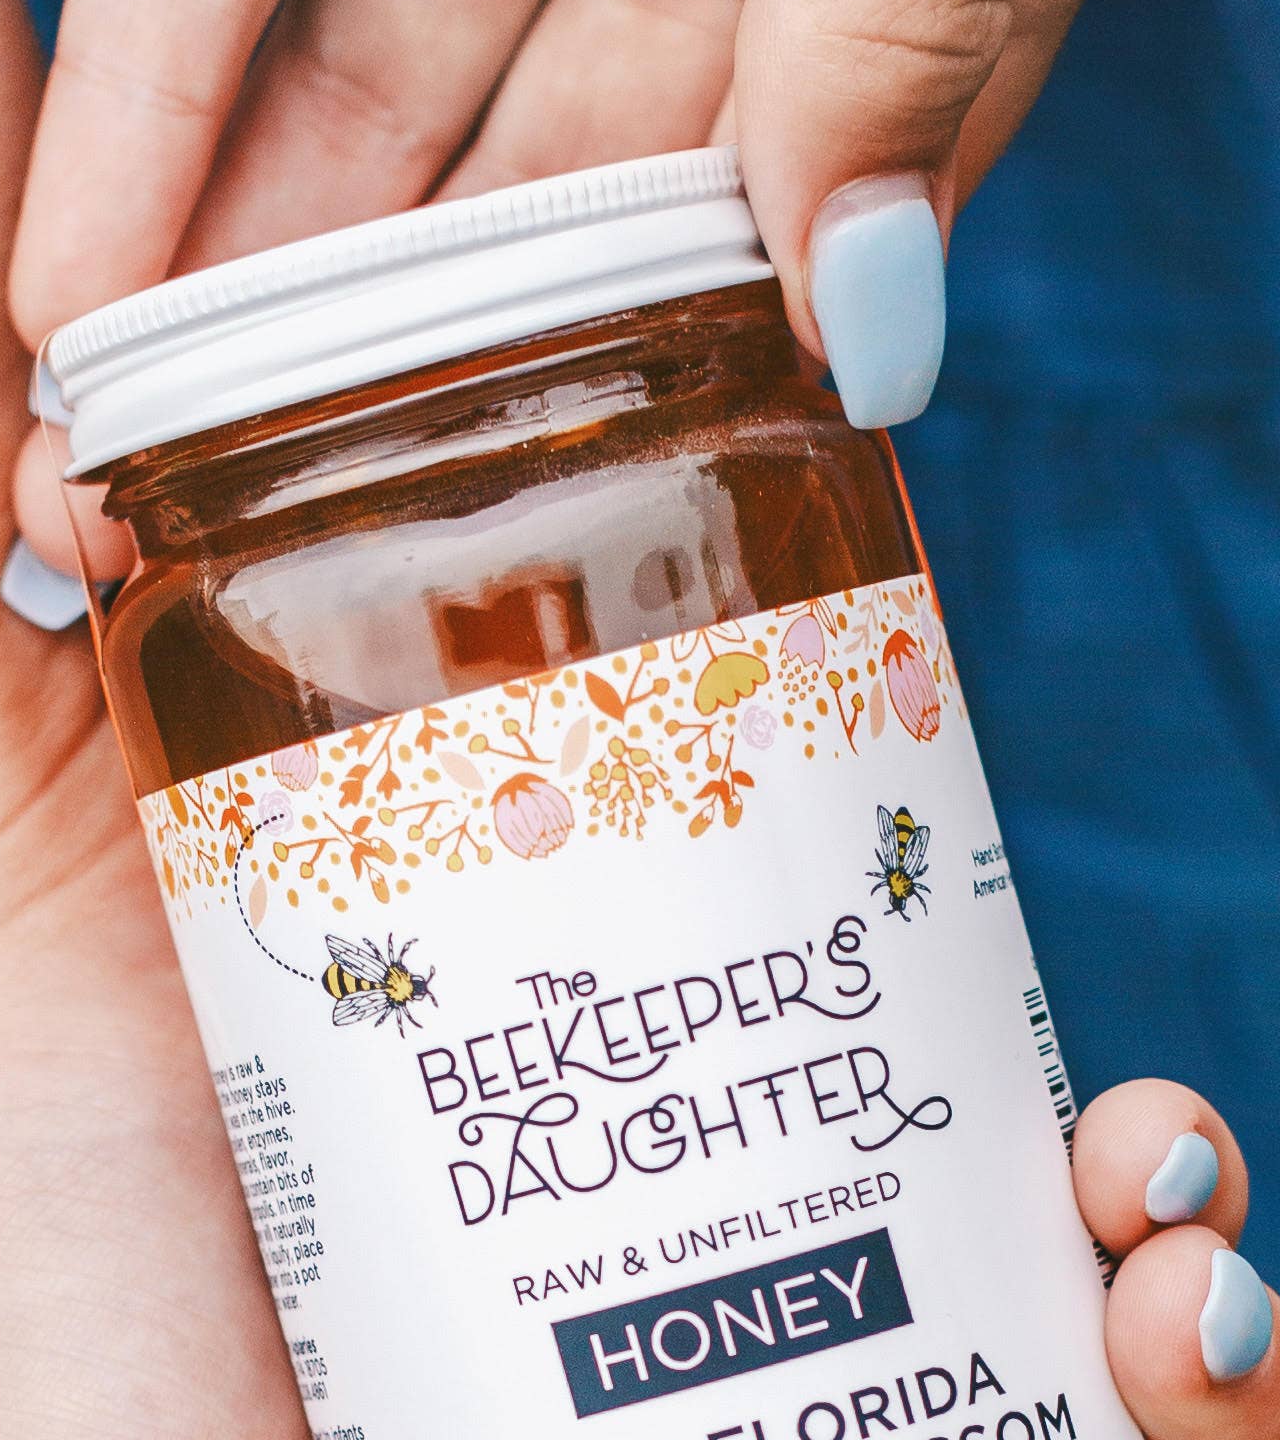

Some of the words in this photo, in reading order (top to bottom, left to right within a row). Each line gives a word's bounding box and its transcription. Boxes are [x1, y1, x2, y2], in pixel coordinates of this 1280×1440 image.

[515, 970, 597, 1010] The
[417, 915, 882, 1115] BEEKEEPER'S
[235, 1060, 253, 1079] raw
[254, 1054, 265, 1074] &
[255, 1077, 287, 1099] stays
[248, 1106, 265, 1125] the
[264, 1099, 296, 1121] hive.
[247, 1126, 293, 1150] enzymes,
[448, 1046, 953, 1226] DAUGHTER
[259, 1150, 295, 1172] flavor,
[277, 1169, 300, 1191] bits
[301, 1163, 316, 1185] of
[287, 1192, 317, 1213] time
[272, 1214, 316, 1239] naturally
[512, 1255, 604, 1306] RAW
[622, 1246, 649, 1276] &
[659, 1171, 902, 1265] UNFILTERED
[293, 1239, 324, 1261] place
[300, 1263, 322, 1286] pot
[589, 1256, 870, 1392] HONEY
